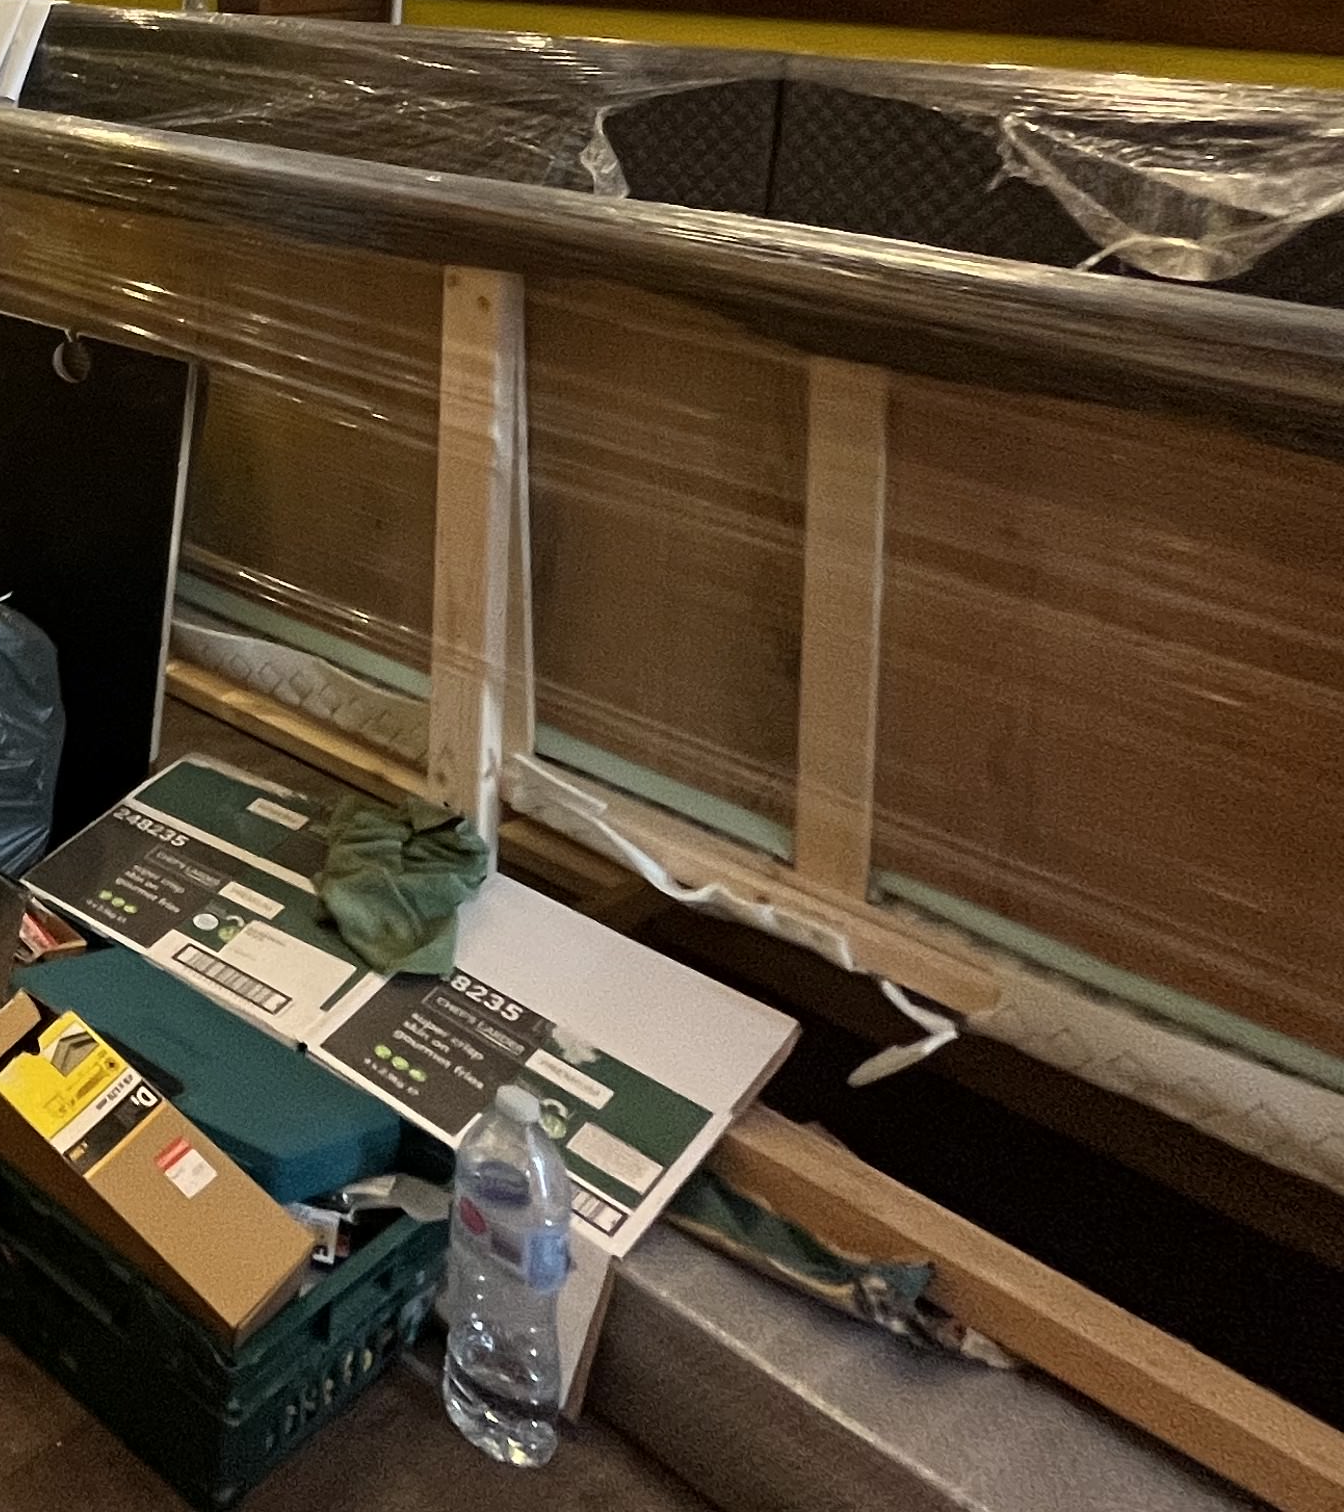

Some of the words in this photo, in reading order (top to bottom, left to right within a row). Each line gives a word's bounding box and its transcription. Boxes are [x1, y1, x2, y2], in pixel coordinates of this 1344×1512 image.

[112, 807, 191, 847] 248235
[446, 974, 524, 1022] 8235
[431, 1039, 451, 1054] on
